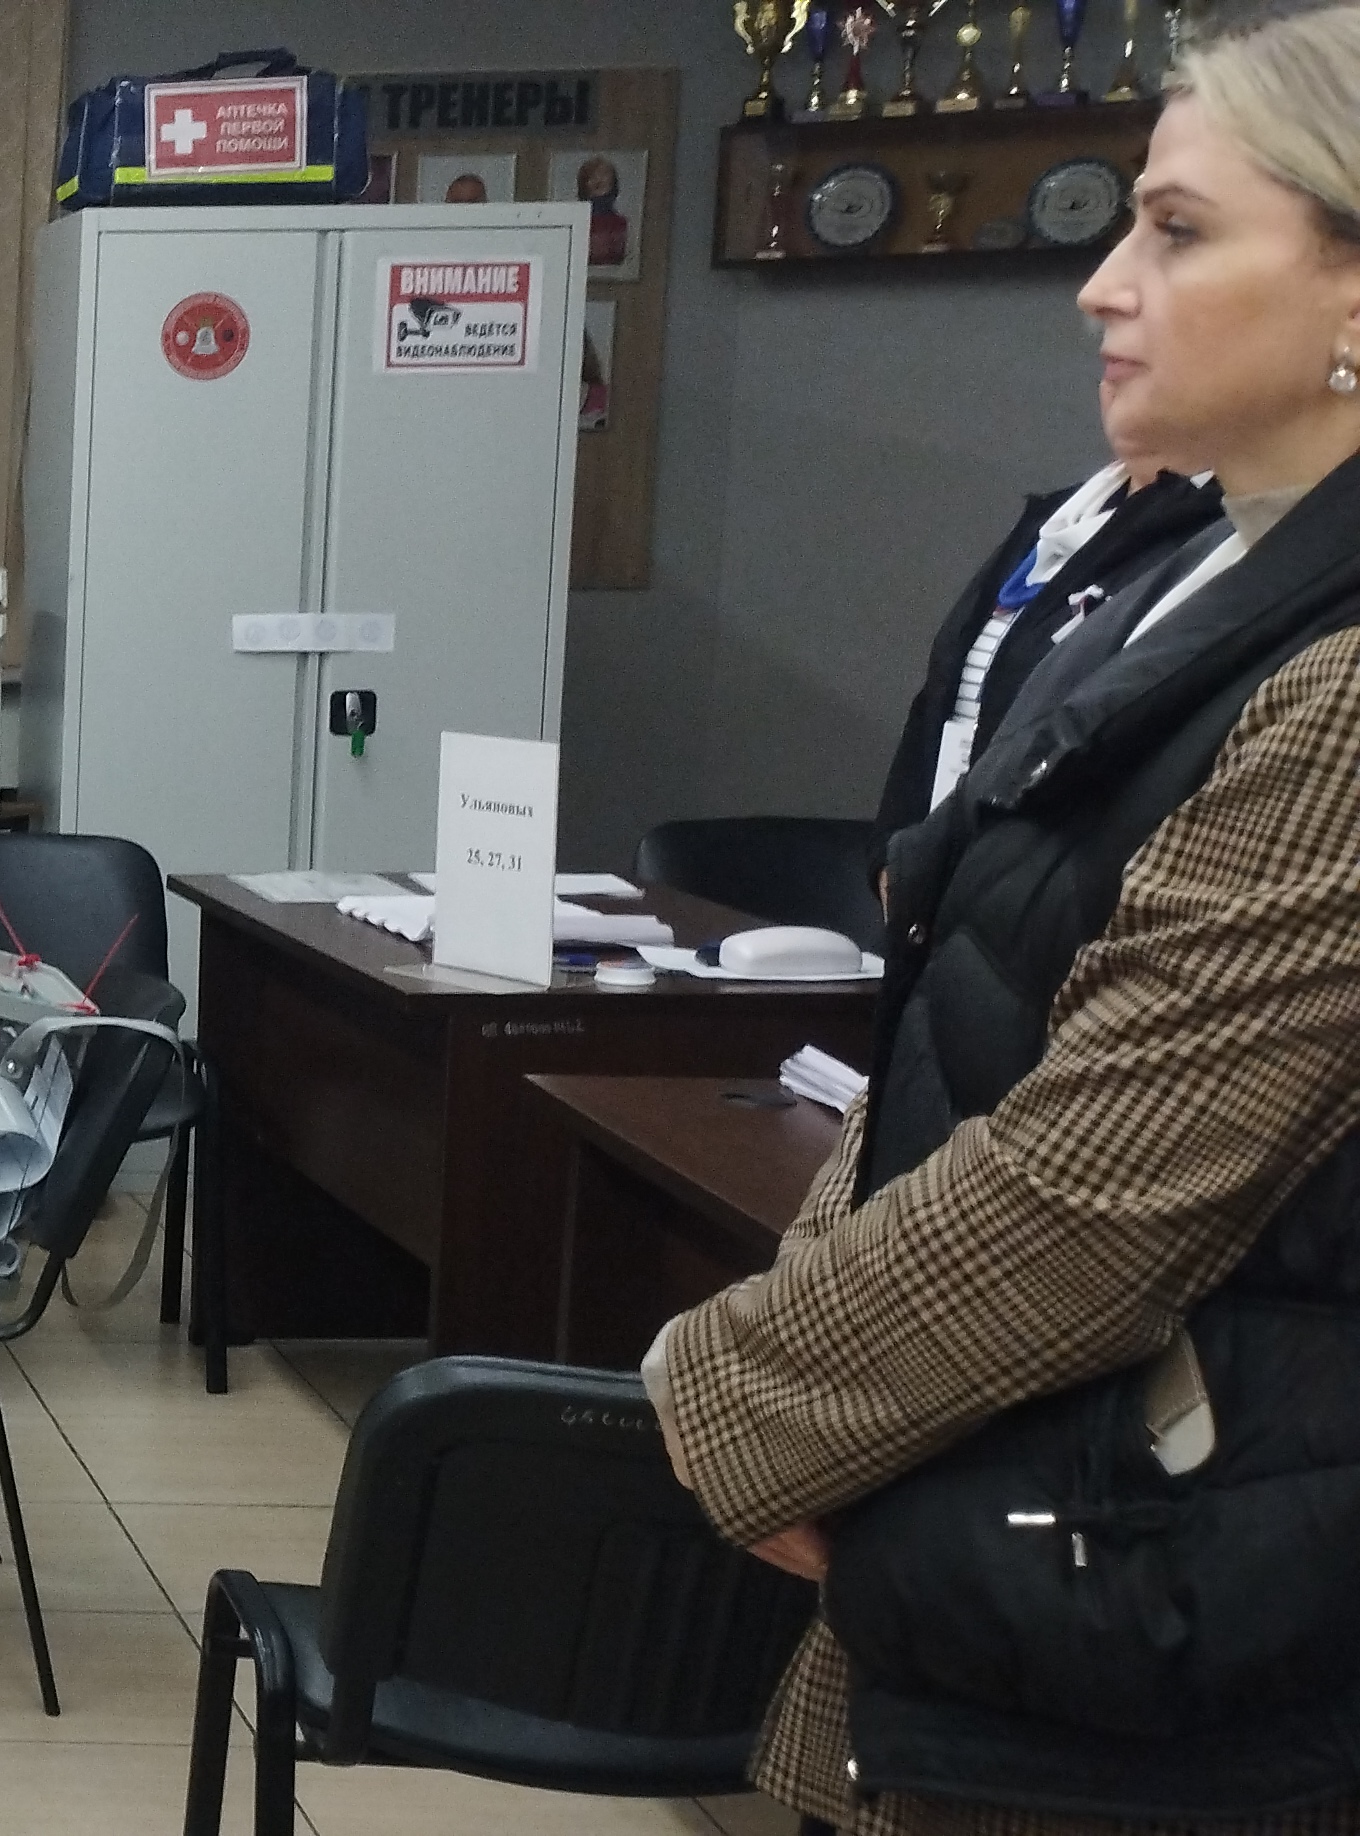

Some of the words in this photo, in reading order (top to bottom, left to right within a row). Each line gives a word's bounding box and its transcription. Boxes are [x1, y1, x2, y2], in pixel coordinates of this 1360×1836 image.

[216, 102, 288, 119] АПТЕЧКА
[382, 80, 590, 129] ТРЕНЕРЫ
[220, 118, 285, 136] ПЕРВОЙ
[216, 136, 288, 153] ПОМОЩИ
[399, 265, 519, 296] ВНИМАНИЕ
[396, 343, 515, 359] ВИДЕОНАБЛЮДЕНИЕ
[461, 793, 533, 817] Ульяновых
[467, 848, 484, 867] 25,
[487, 851, 504, 871] 27,
[508, 854, 521, 871] 31
